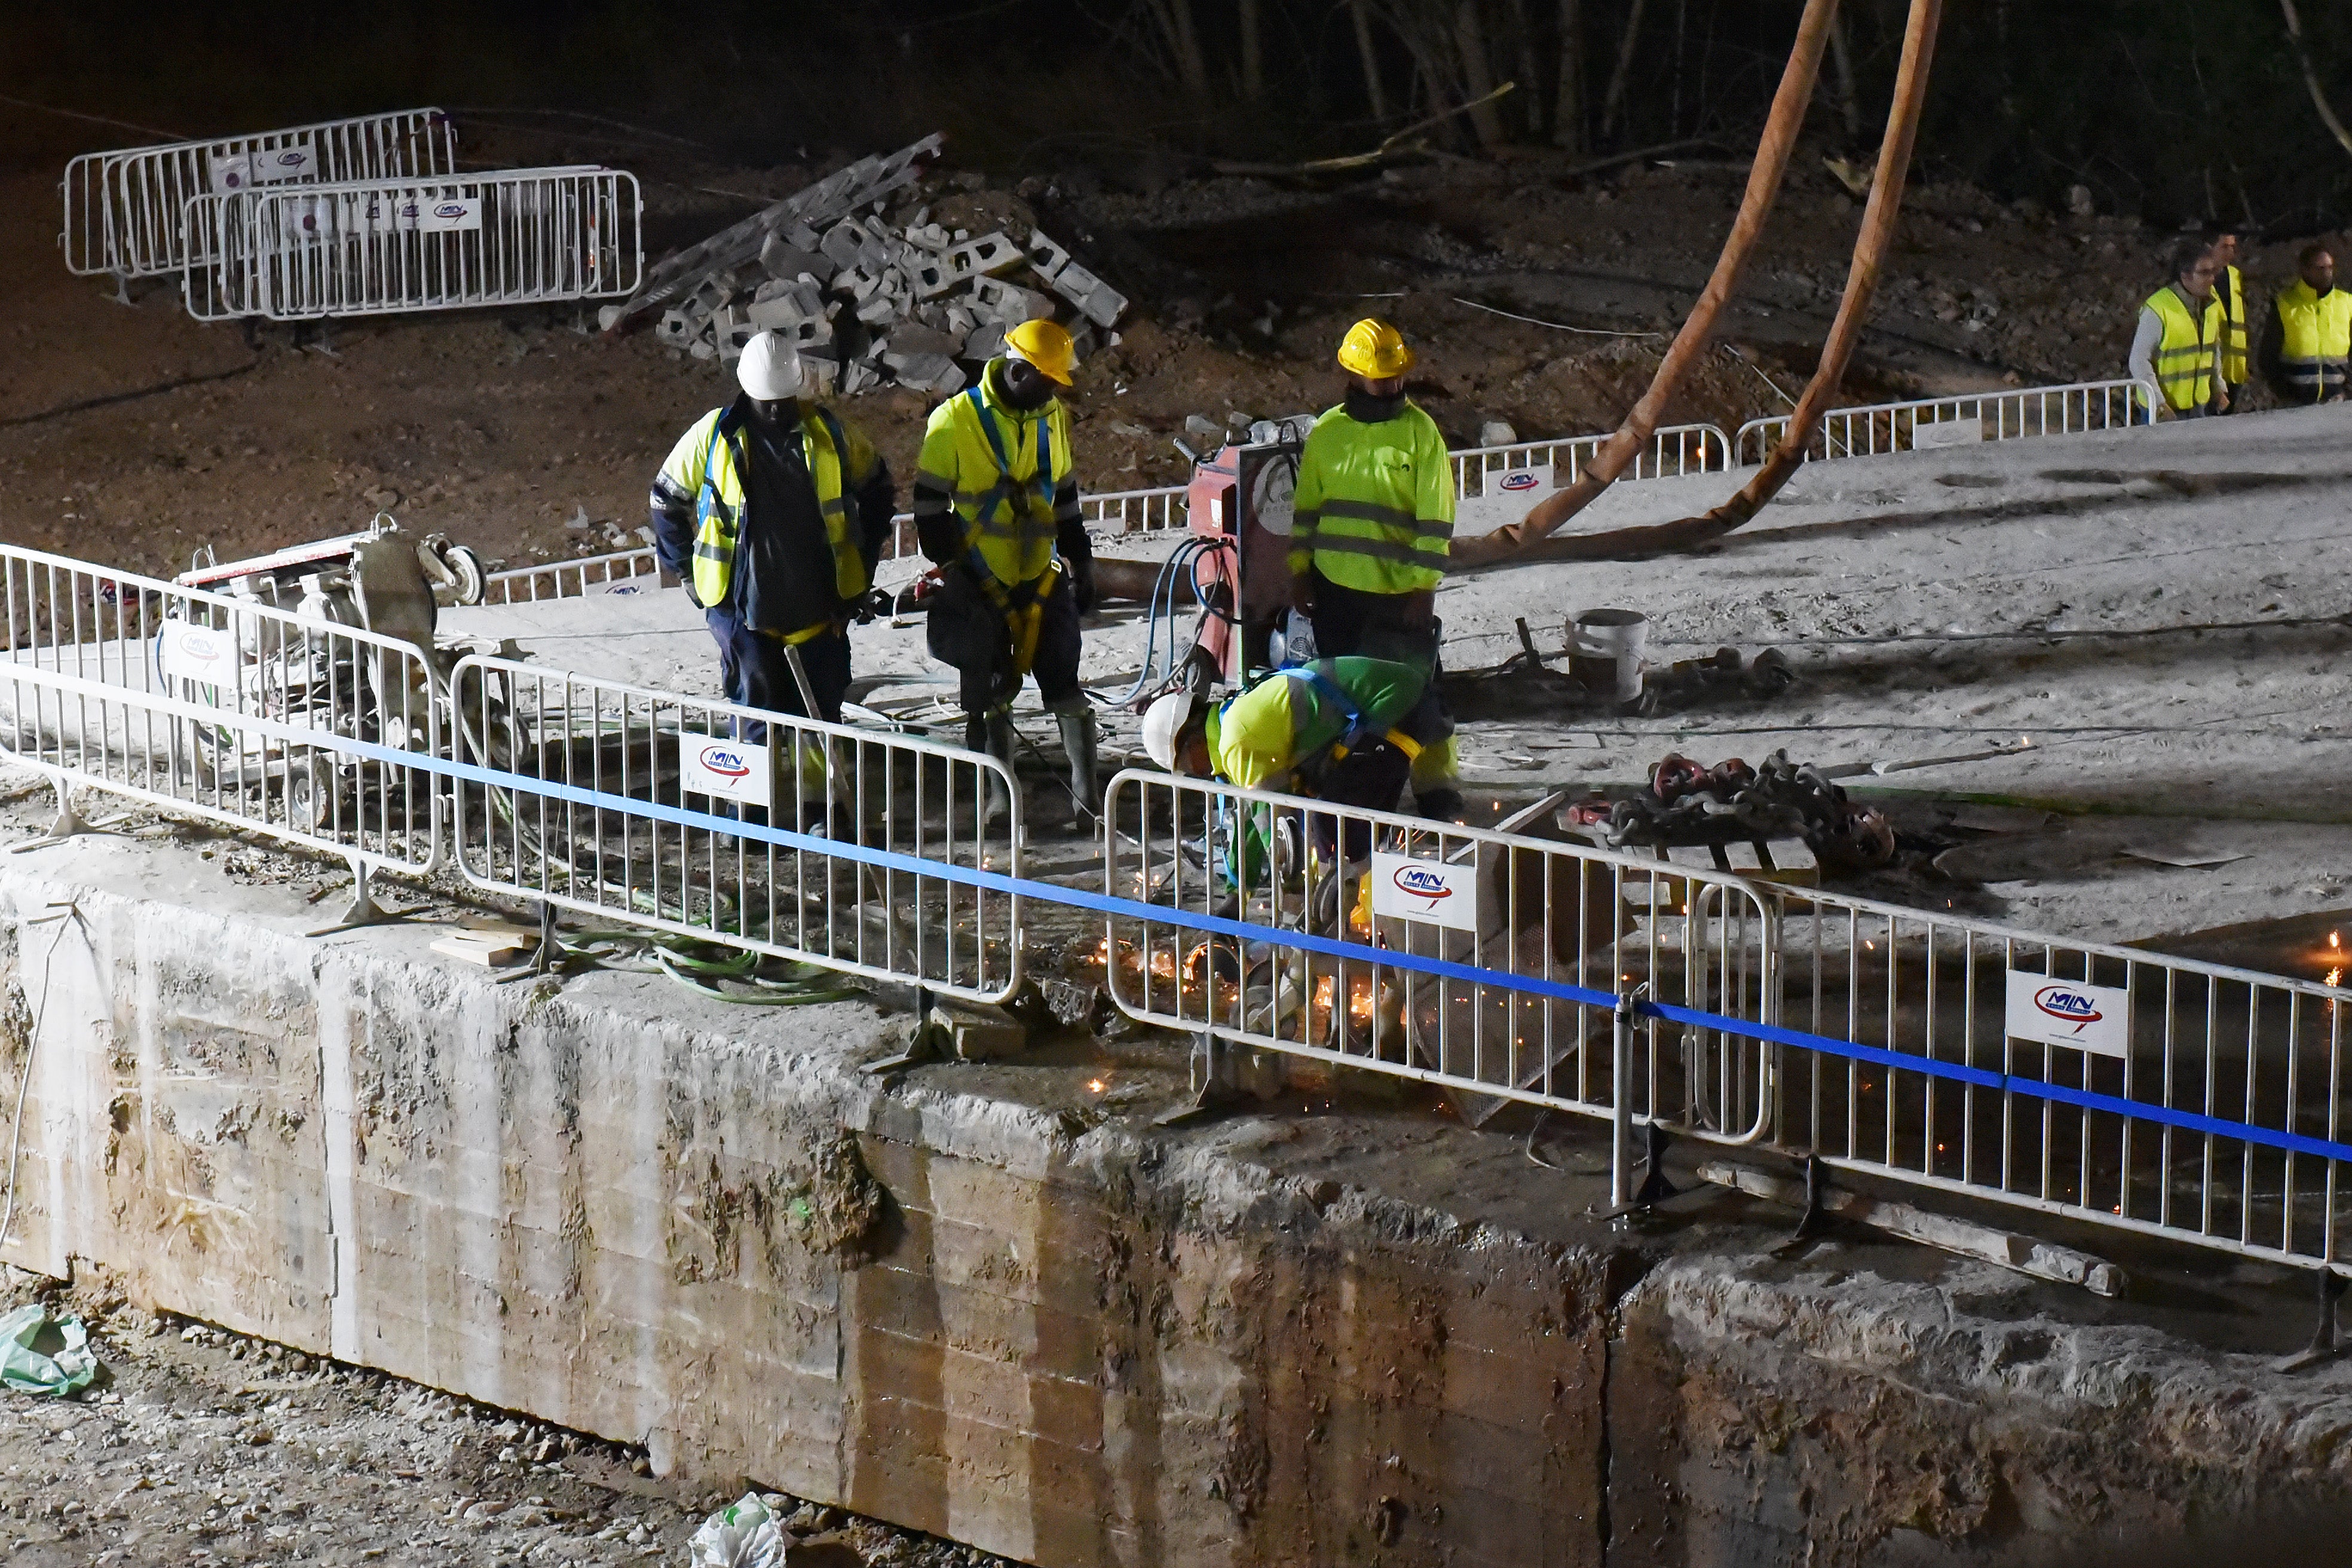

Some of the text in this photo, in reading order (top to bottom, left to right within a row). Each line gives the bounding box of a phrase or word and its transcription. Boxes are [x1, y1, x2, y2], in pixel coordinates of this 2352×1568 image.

[1508, 473, 1534, 484] MIN
[614, 585, 640, 595] MIN
[186, 637, 215, 651] MIN
[710, 751, 743, 767] MIN
[1405, 871, 1445, 887] MIN
[2048, 991, 2095, 1010] MIN
